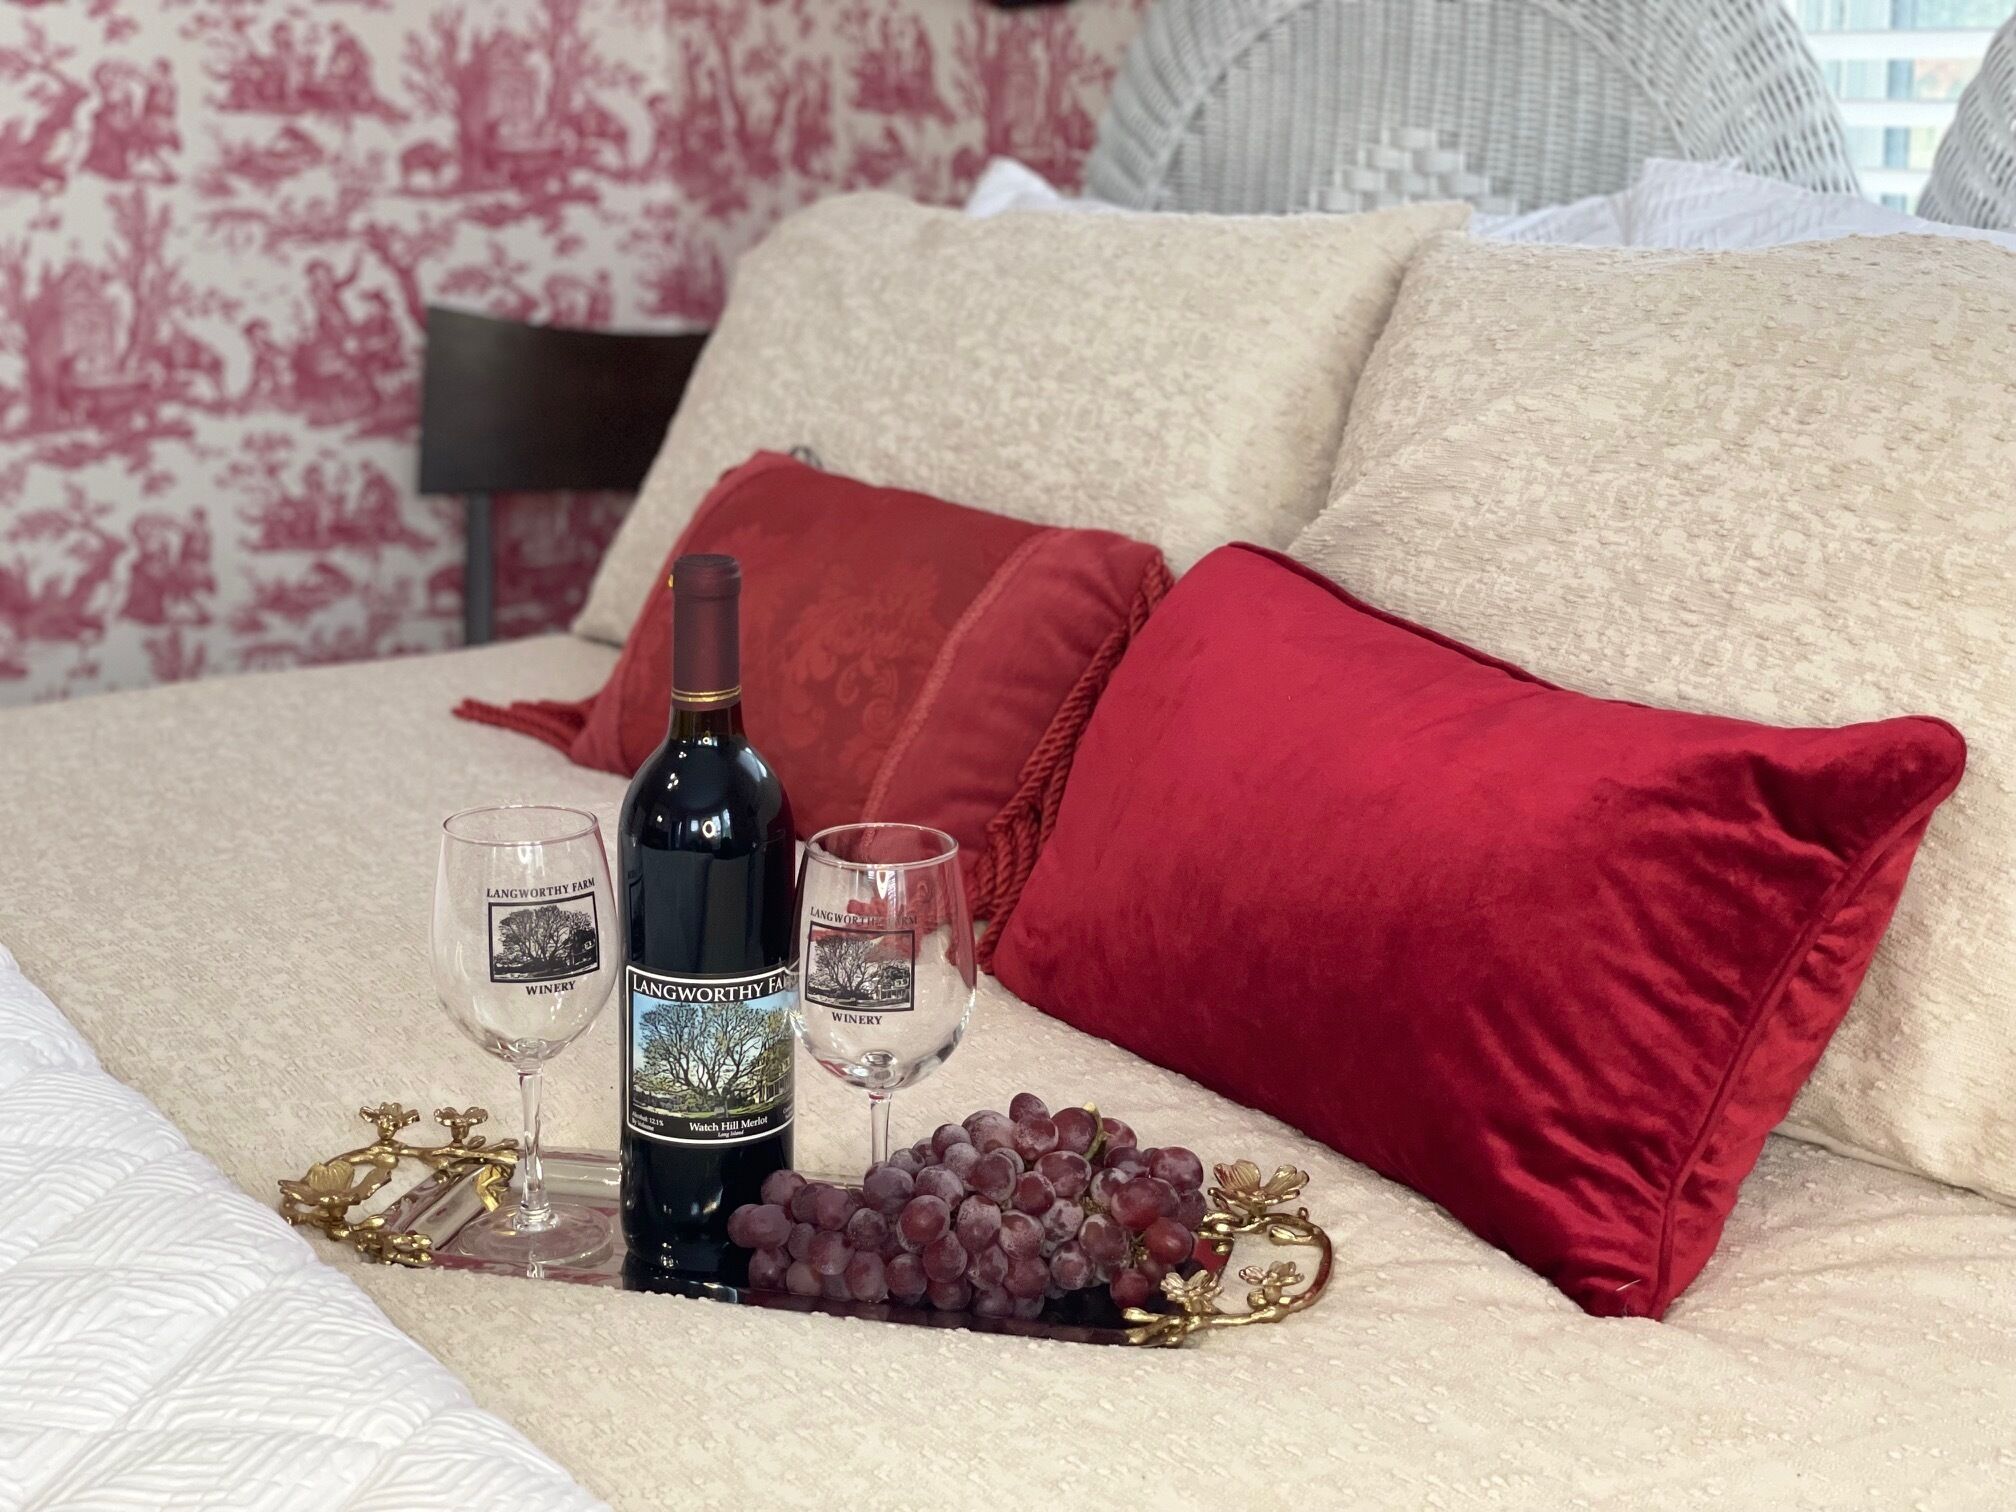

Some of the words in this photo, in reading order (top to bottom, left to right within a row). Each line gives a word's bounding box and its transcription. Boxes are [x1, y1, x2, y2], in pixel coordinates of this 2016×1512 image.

[486, 883, 569, 899] LANGWORTHY
[572, 877, 596, 892] FARM
[810, 906, 880, 926] LANGWORTH
[525, 980, 577, 995] WINERY
[633, 974, 763, 1002] LANGWORTHY
[831, 1011, 883, 1025] WINERY
[689, 1122, 719, 1132] Watch
[721, 1120, 739, 1131] Hill
[741, 1116, 768, 1129] Merlot
